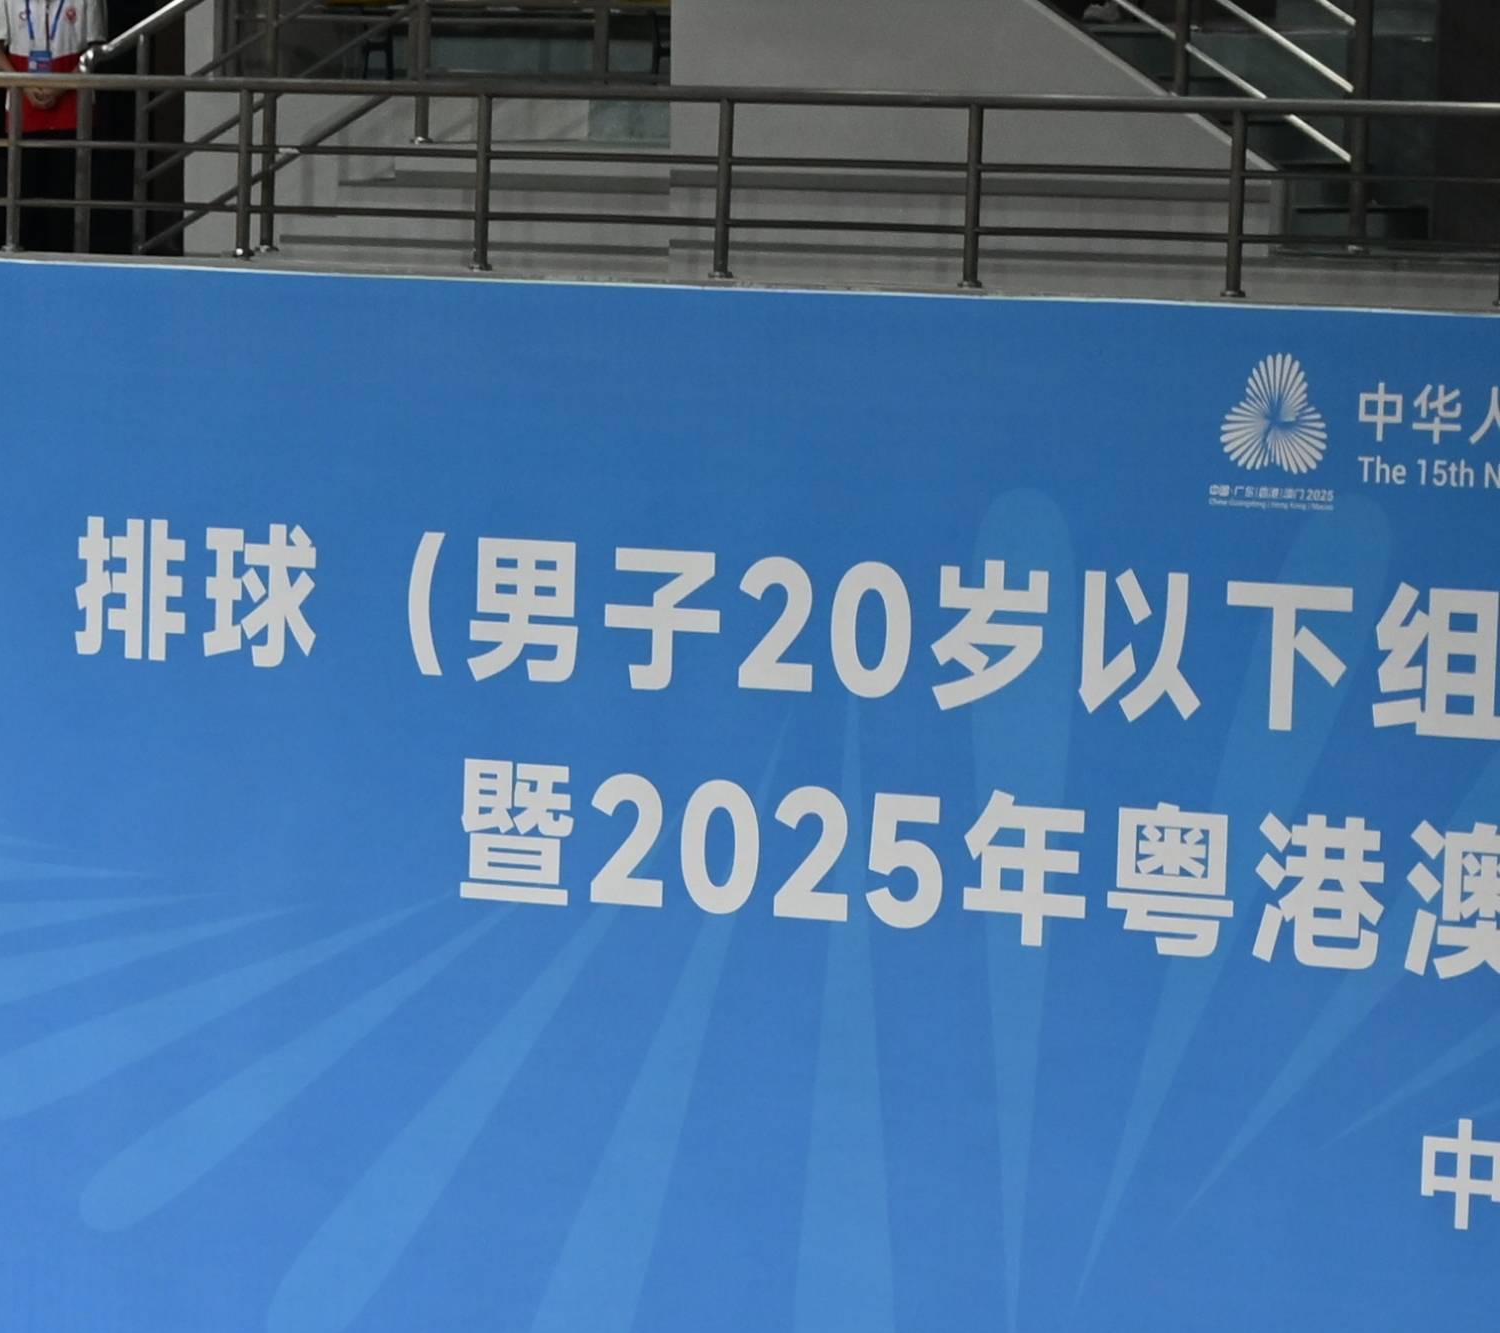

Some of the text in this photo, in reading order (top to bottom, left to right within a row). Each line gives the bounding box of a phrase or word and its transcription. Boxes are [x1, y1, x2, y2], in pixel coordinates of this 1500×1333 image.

[1358, 455, 1406, 485] The
[1417, 458, 1474, 488] 15th
[1420, 1118, 1500, 1231] 中
